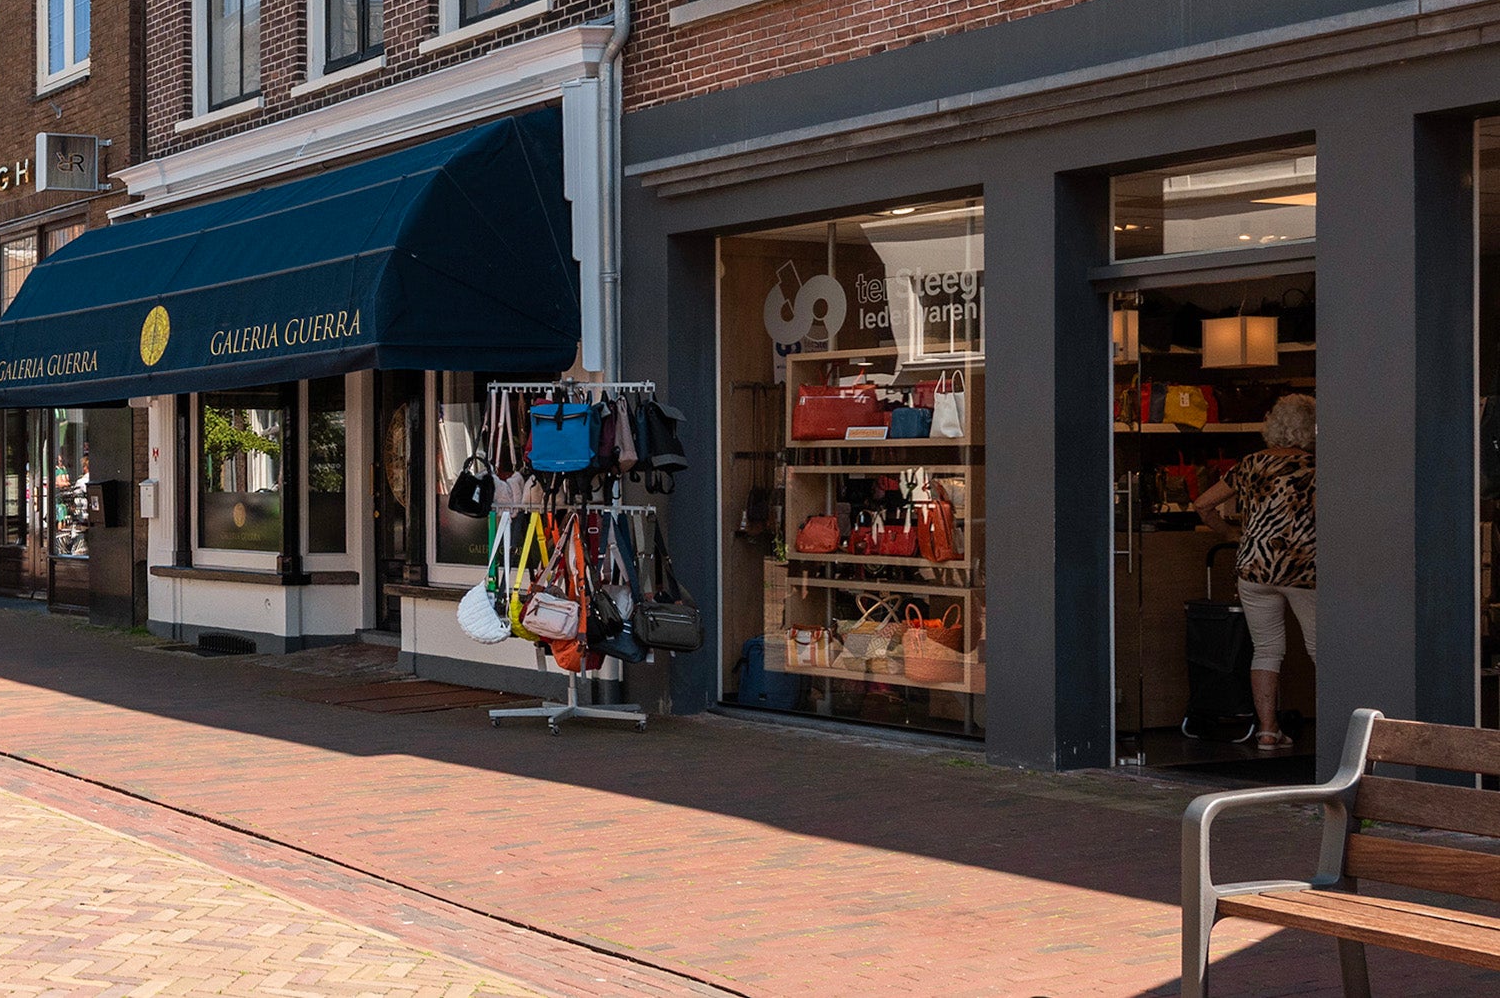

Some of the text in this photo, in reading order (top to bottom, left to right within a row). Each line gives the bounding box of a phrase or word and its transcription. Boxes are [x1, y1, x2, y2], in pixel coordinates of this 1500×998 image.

[210, 308, 361, 356] GALERIA GUERRA
[47, 350, 98, 377] GUERRA
